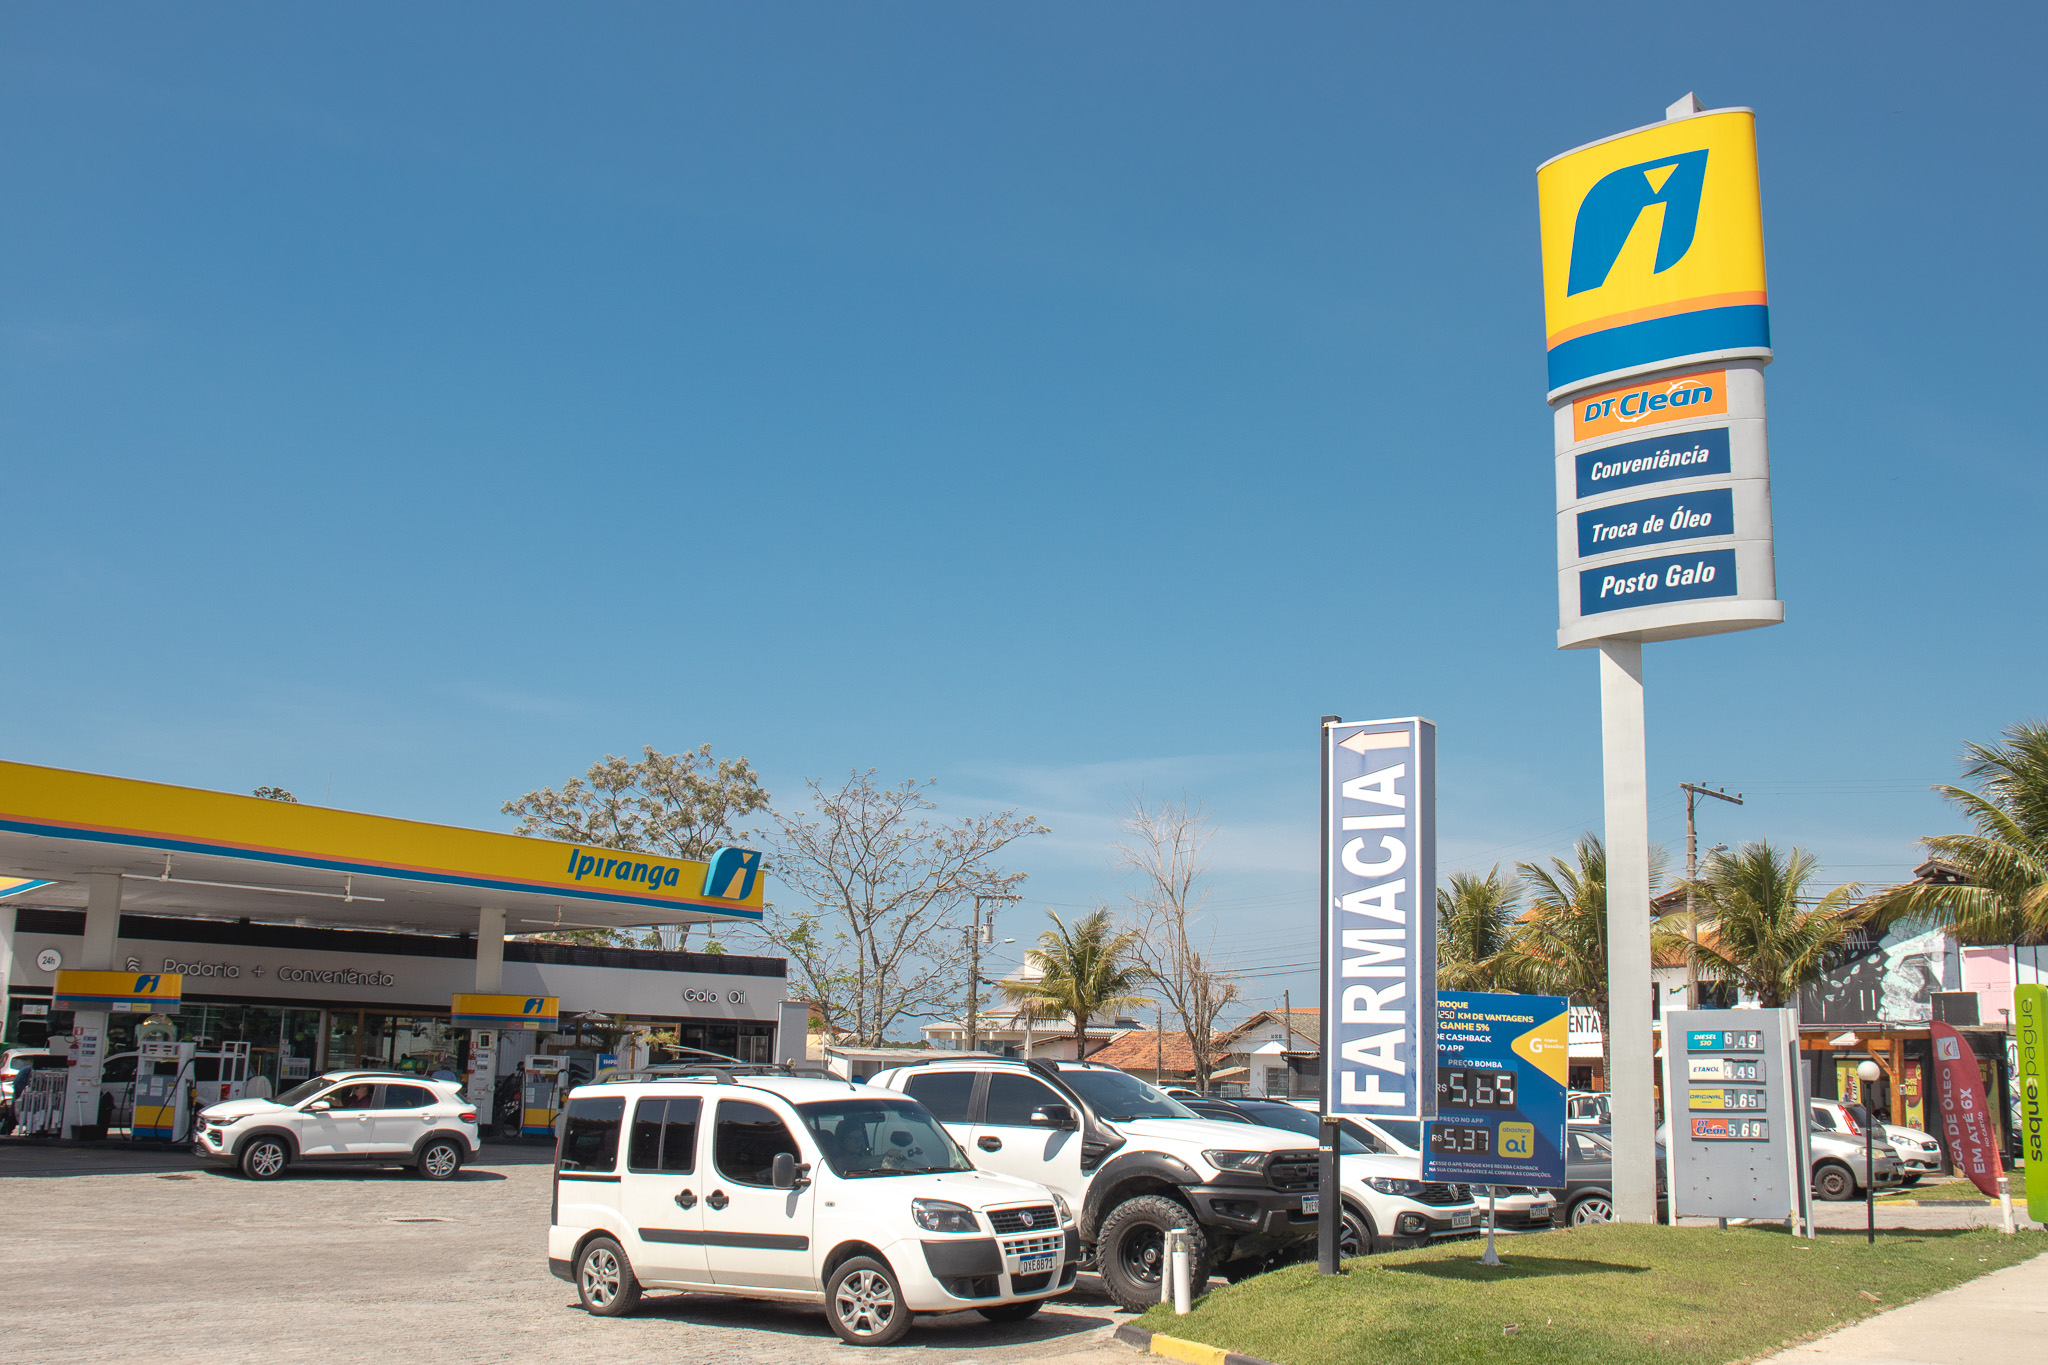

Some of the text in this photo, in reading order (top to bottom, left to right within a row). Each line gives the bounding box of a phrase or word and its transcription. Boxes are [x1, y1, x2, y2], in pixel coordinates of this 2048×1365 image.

[1584, 385, 1713, 423] DT Clean
[1591, 445, 1709, 481] Conveniência
[1592, 506, 1712, 543] Troca de Óleo
[1600, 561, 1716, 598] Posto Galo
[567, 848, 680, 891] Ipiranga
[1334, 762, 1407, 1107] FARMÁCIA
[42, 956, 56, 965] 24h
[163, 958, 240, 978] Padaria
[278, 966, 394, 987] Conveniência
[683, 988, 746, 1004] Galo Oil
[1440, 1021, 1475, 1031] GANHE
[1476, 1023, 1490, 1032] 5%
[1458, 1012, 1471, 1020] KM
[1472, 1013, 1484, 1021] DE
[1485, 1014, 1534, 1023] VANTAGENS
[1446, 1034, 1492, 1043] CASHBACK
[1529, 1038, 1542, 1053] G
[1725, 1032, 1757, 1049] 6,49
[1448, 1059, 1503, 1068] PREÇO BOMBA
[1725, 1066, 1756, 1079] 4,49
[1449, 1073, 1514, 1107] 5,65
[1696, 1125, 1726, 1134] Clean
[1728, 1122, 1761, 1137] 5,69
[1942, 1068, 1966, 1174] OCA DE ÓLEO
[1960, 1088, 1986, 1173] EM ATÉ 6X
[1978, 1112, 1990, 1147] NO CARTÃO
[1431, 1128, 1489, 1152] R$ 5,37
